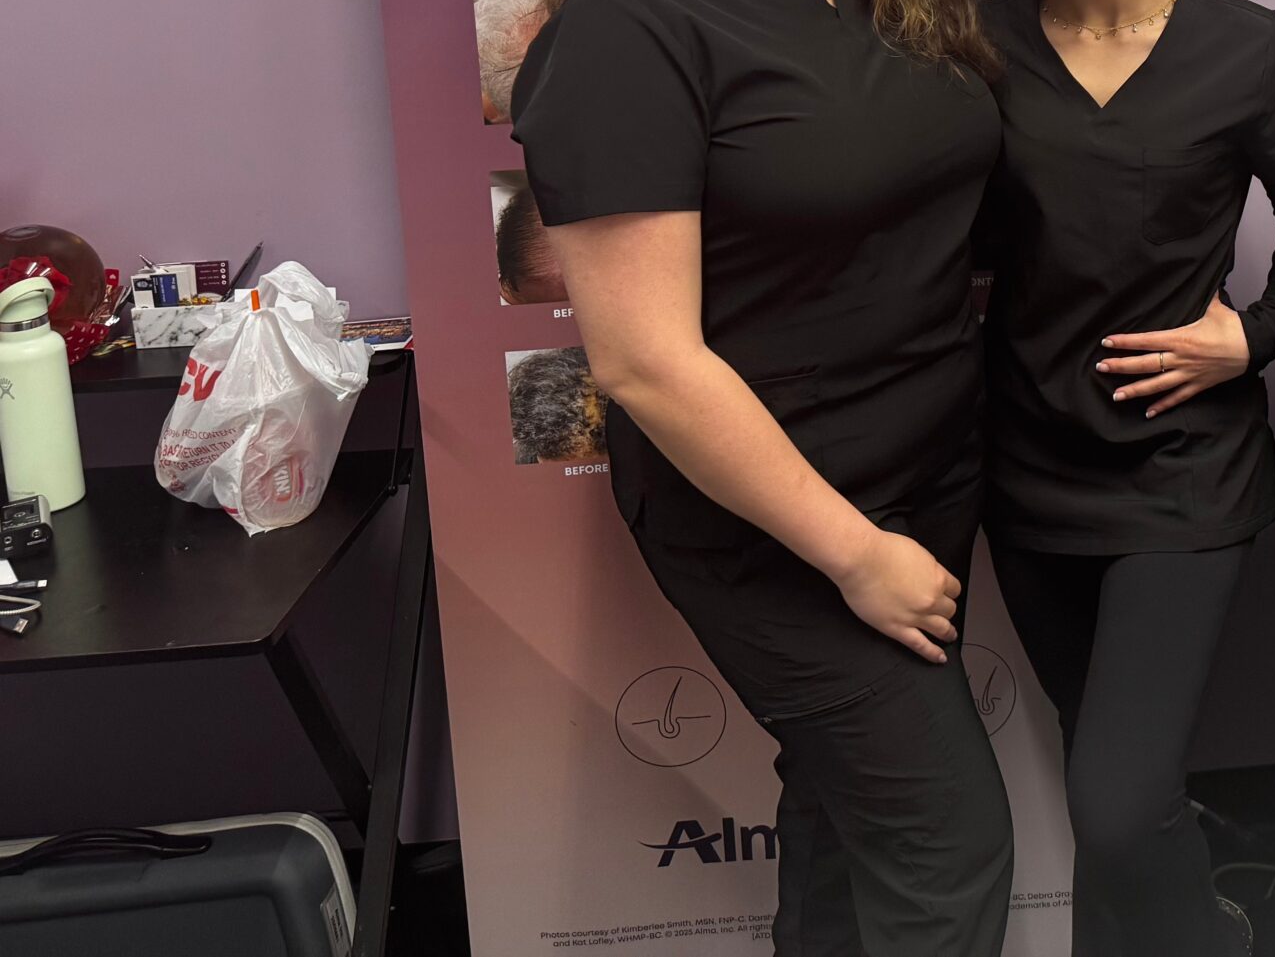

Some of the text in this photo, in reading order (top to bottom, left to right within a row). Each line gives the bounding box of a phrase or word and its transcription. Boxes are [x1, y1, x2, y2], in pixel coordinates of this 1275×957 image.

[564, 463, 609, 476] BEFORE
[540, 931, 571, 939] Photos
[571, 928, 609, 937] courtesy
[611, 927, 620, 935] of
[621, 923, 665, 934] Kimberlee
[1027, 891, 1053, 900] Debra
[553, 939, 571, 947] and
[572, 938, 587, 946] Kat
[674, 929, 693, 937] 2025
[737, 924, 748, 932] All
[1052, 899, 1061, 907] of
